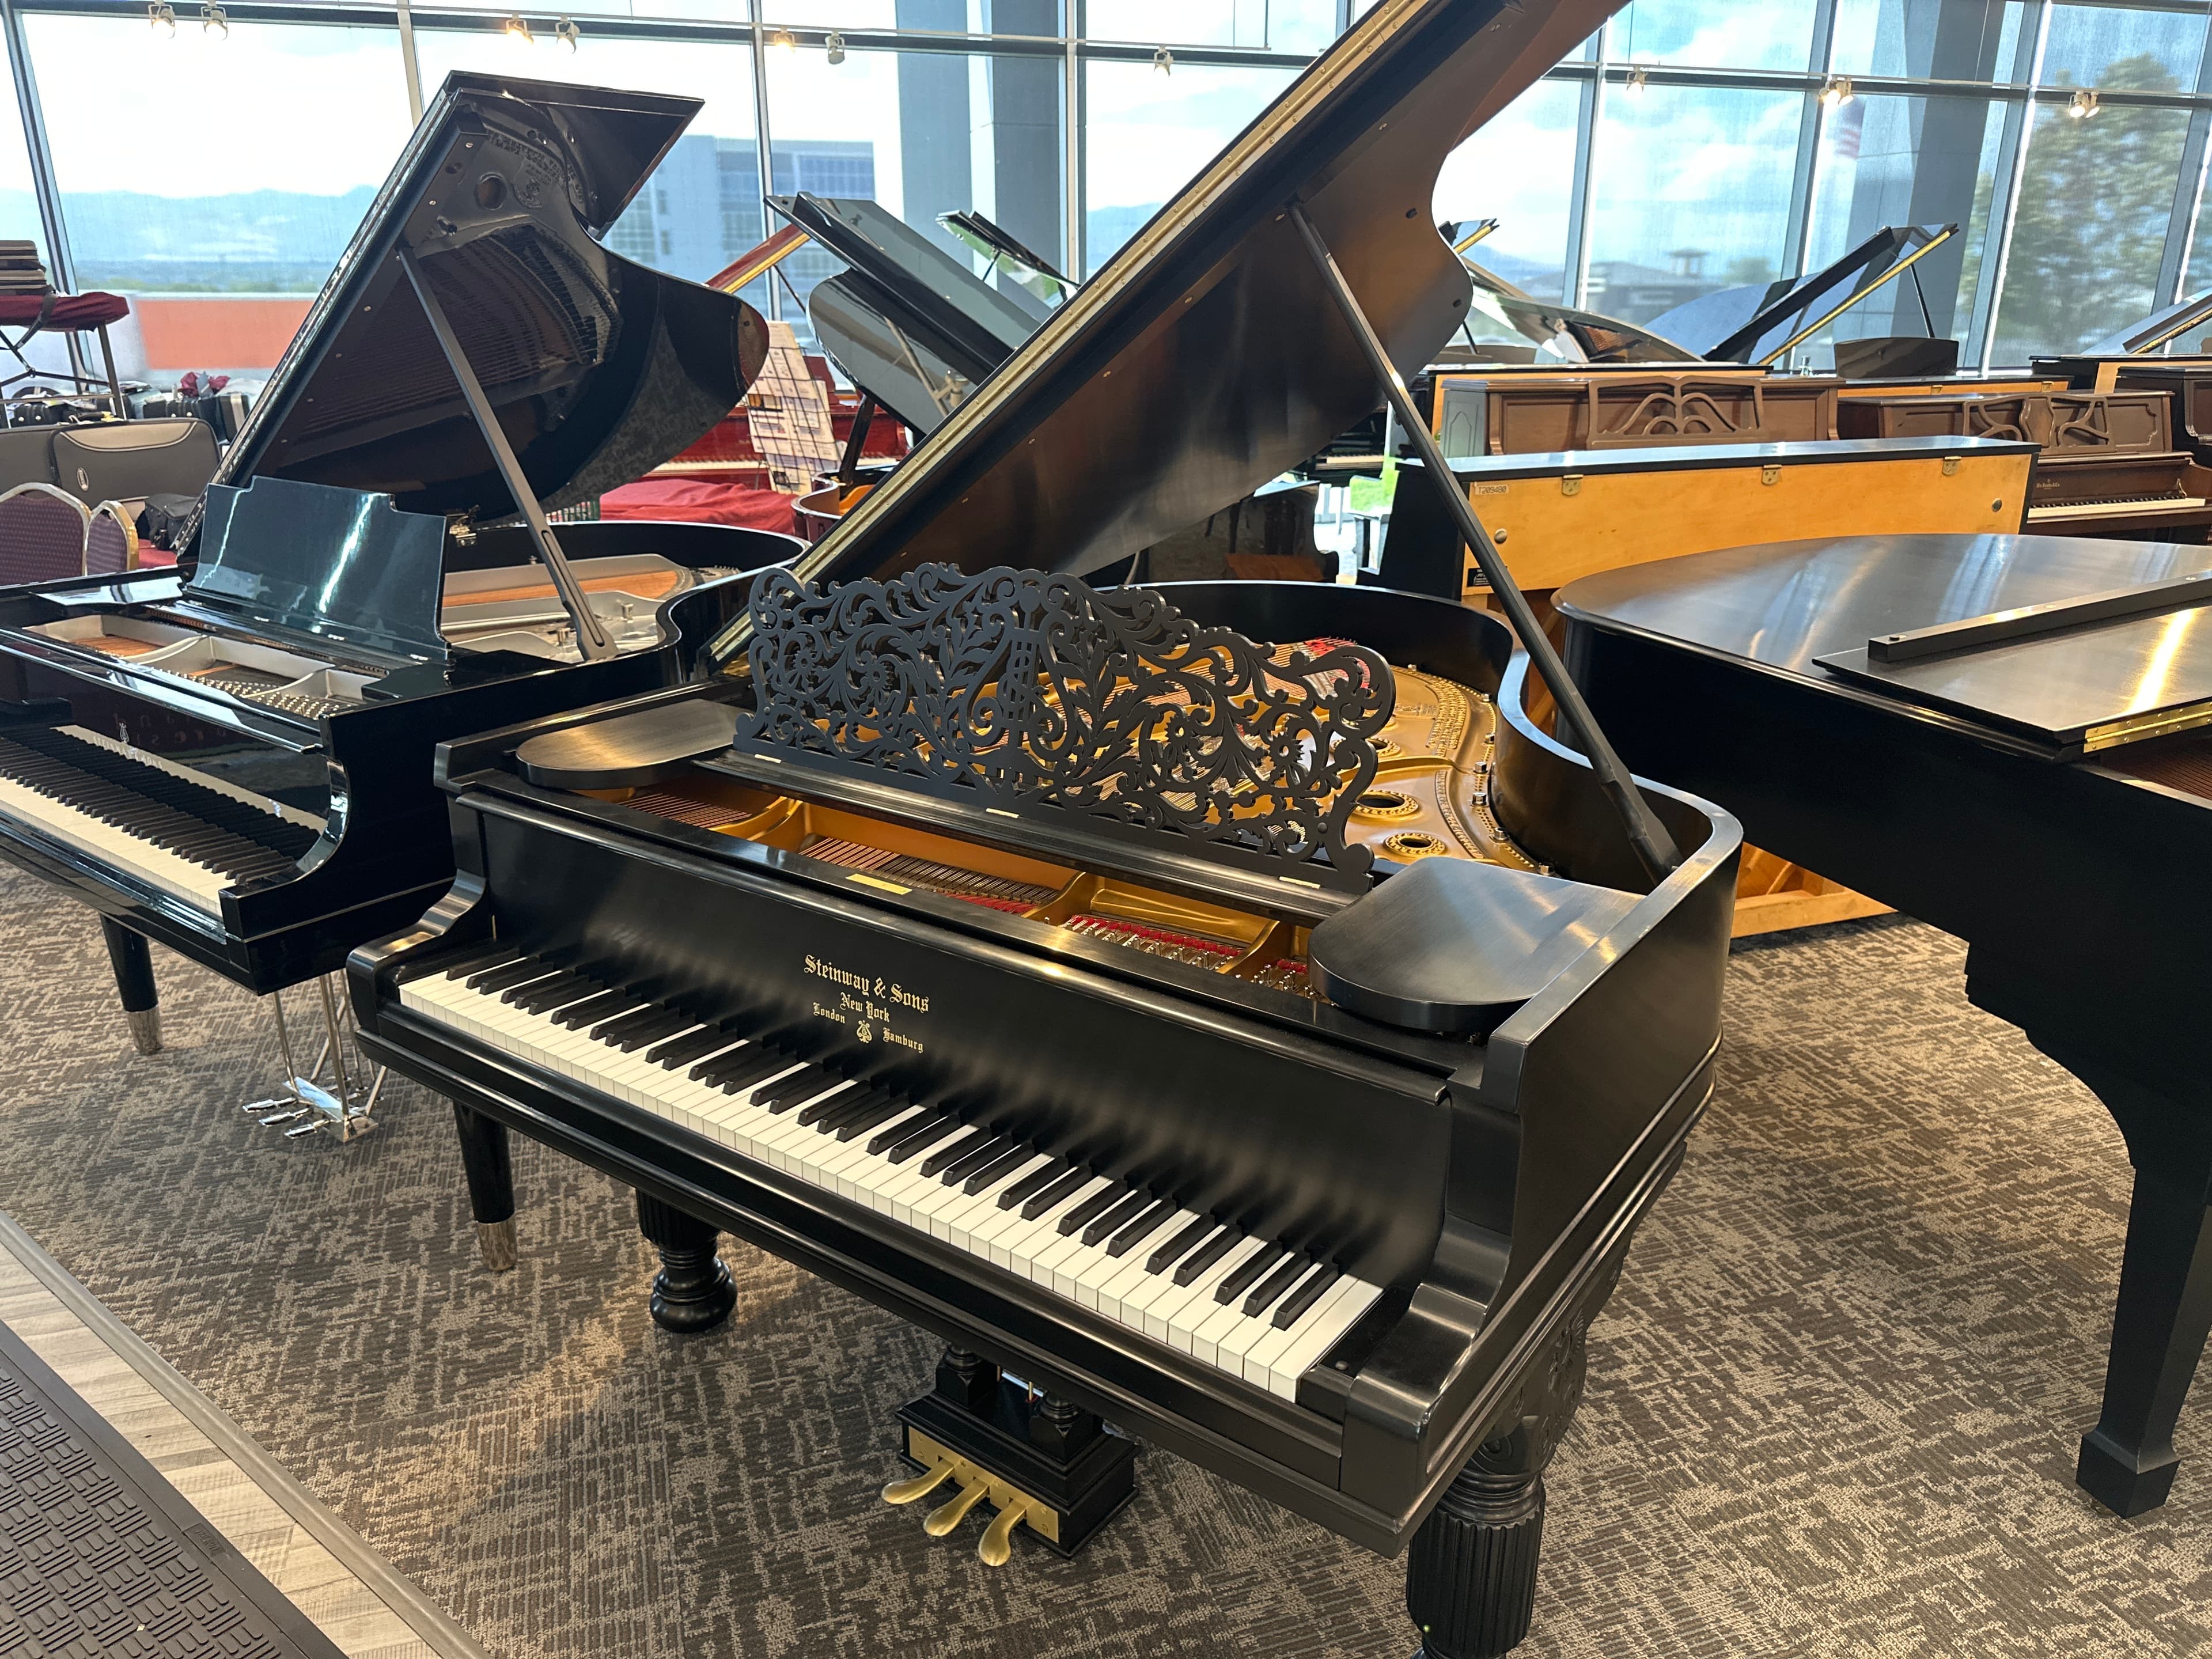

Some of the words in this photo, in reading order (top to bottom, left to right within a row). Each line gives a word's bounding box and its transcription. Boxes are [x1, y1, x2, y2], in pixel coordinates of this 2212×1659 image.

[804, 955, 870, 997] Steinway
[873, 977, 886, 998] &
[889, 983, 929, 1013] Sons
[840, 992, 863, 1012] New
[865, 1001, 890, 1022] York
[813, 1002, 846, 1024] London
[882, 1027, 923, 1054] Hamburg
